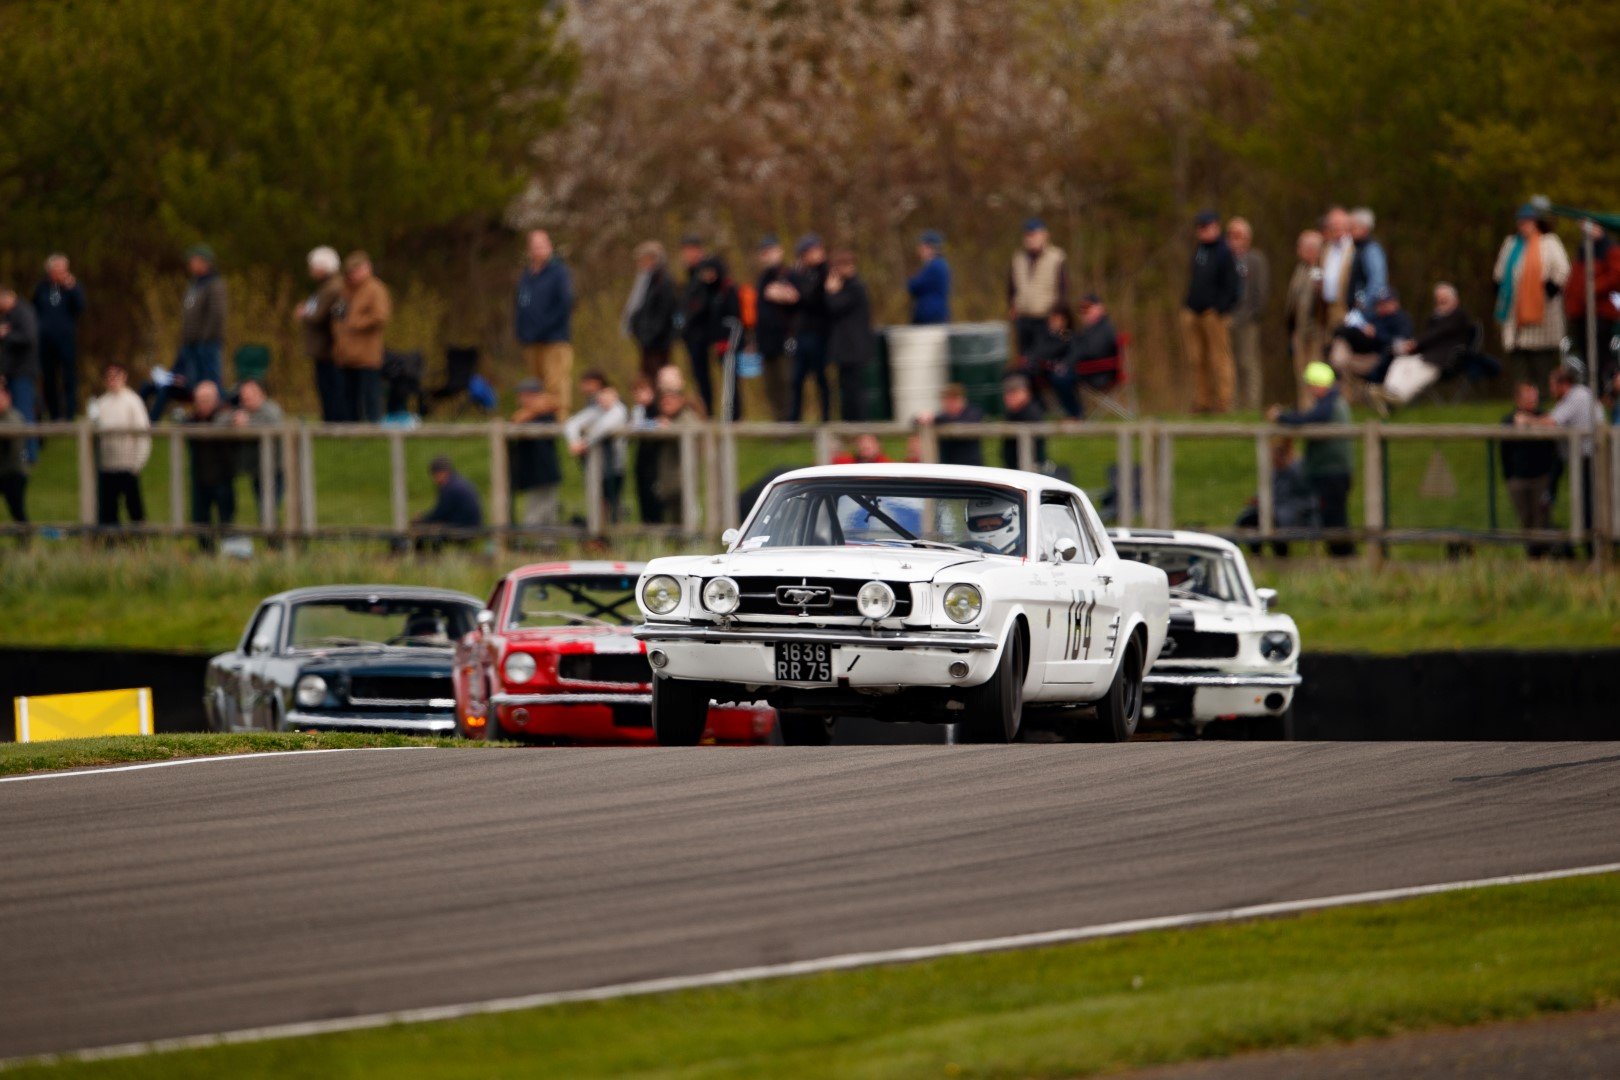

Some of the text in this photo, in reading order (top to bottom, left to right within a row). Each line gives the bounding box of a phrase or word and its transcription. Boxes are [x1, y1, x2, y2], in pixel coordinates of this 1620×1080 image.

[1064, 589, 1096, 660] 184
[782, 642, 826, 662] 1636
[777, 661, 830, 681] RR 75
